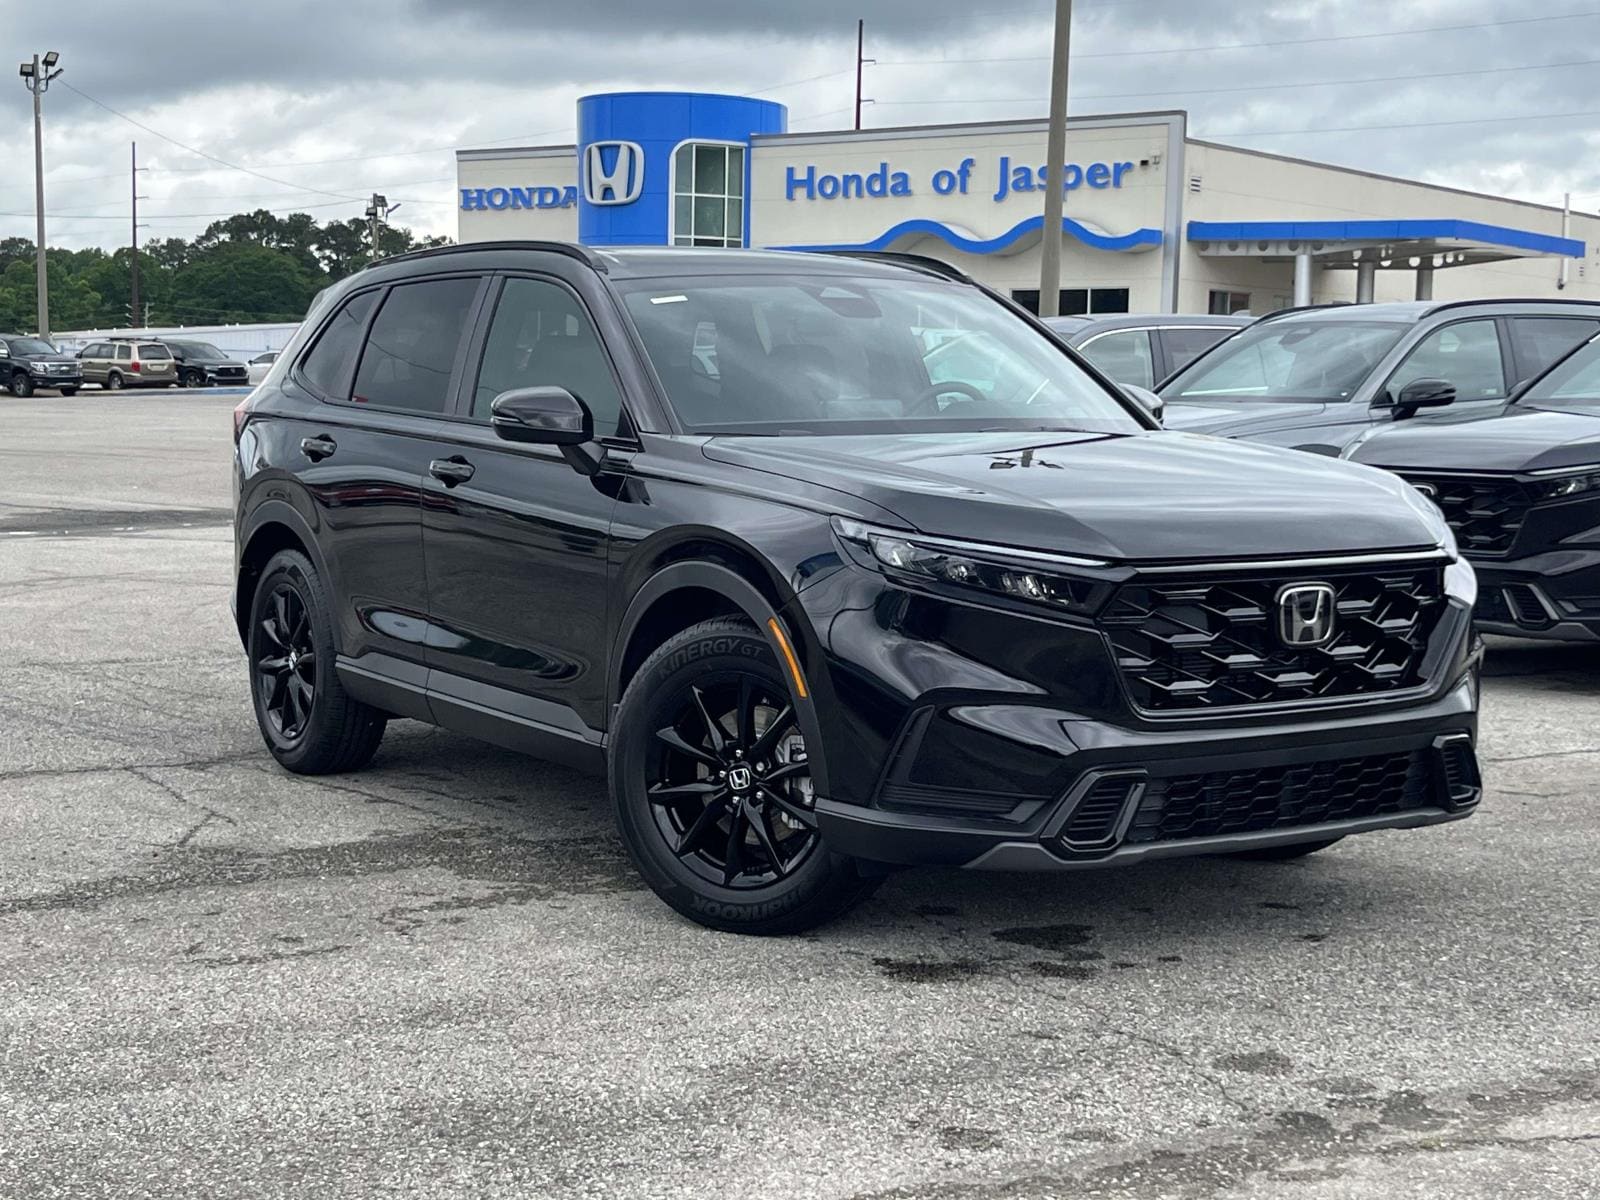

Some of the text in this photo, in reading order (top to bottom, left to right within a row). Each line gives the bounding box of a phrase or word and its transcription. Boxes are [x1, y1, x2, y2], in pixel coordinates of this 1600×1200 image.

[785, 156, 1134, 202] Honda of Jasper
[459, 186, 578, 210] HONDA
[741, 644, 764, 657] GT
